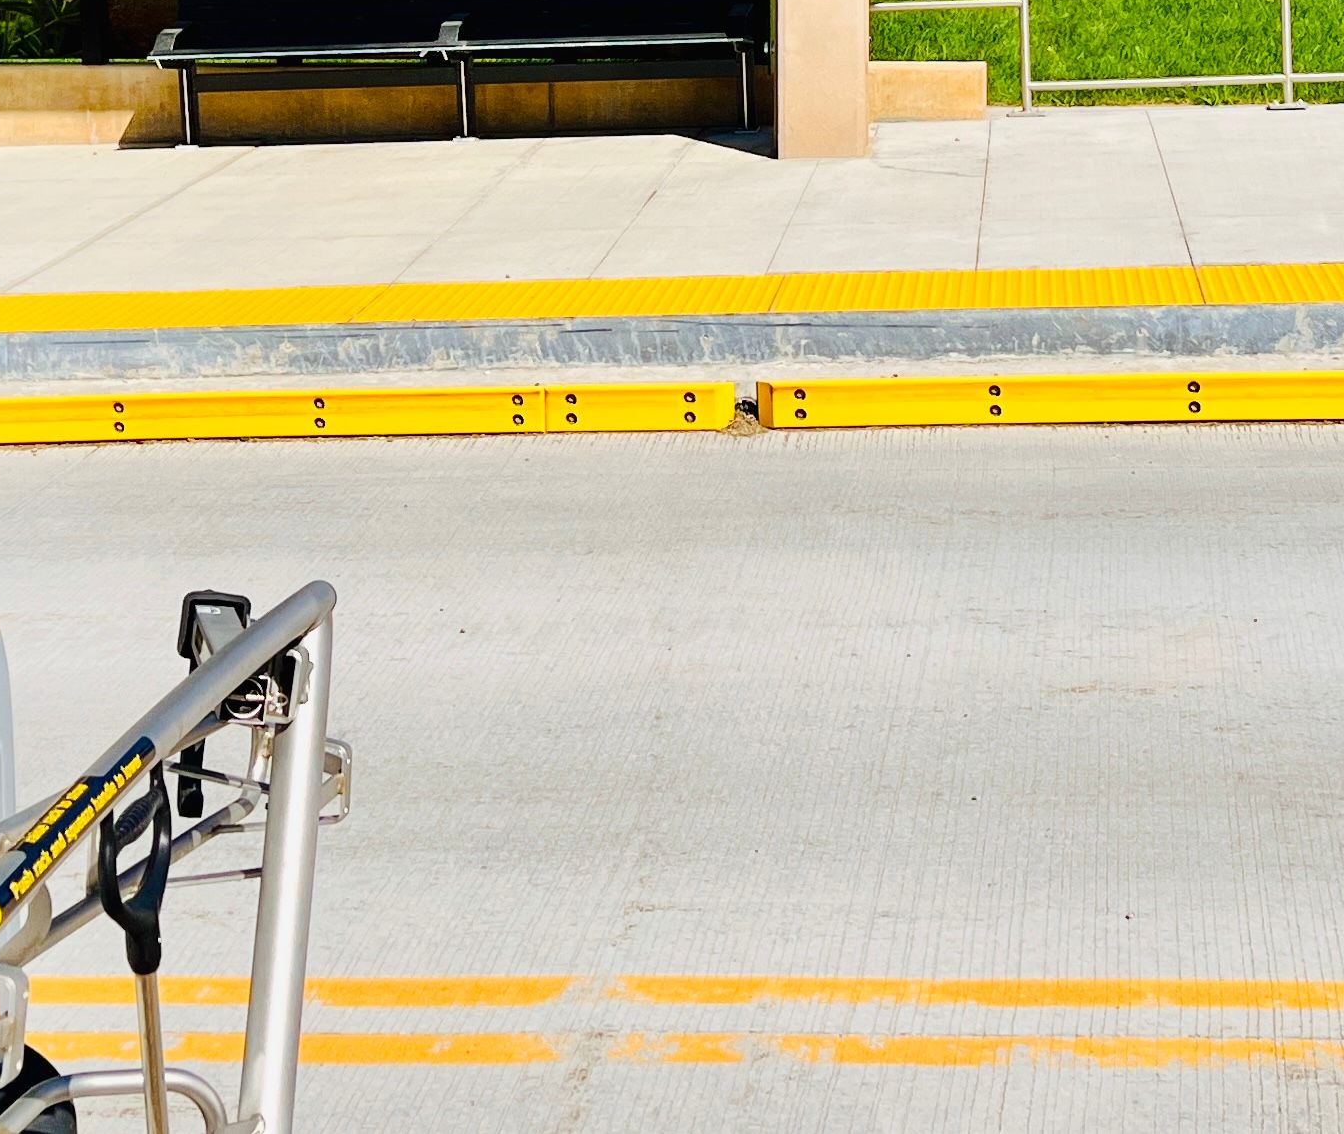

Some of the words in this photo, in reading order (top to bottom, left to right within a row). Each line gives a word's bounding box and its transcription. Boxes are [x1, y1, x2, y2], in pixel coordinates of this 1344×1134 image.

[9, 869, 36, 901] Push
[32, 849, 53, 878] rack
[49, 831, 67, 859] and
